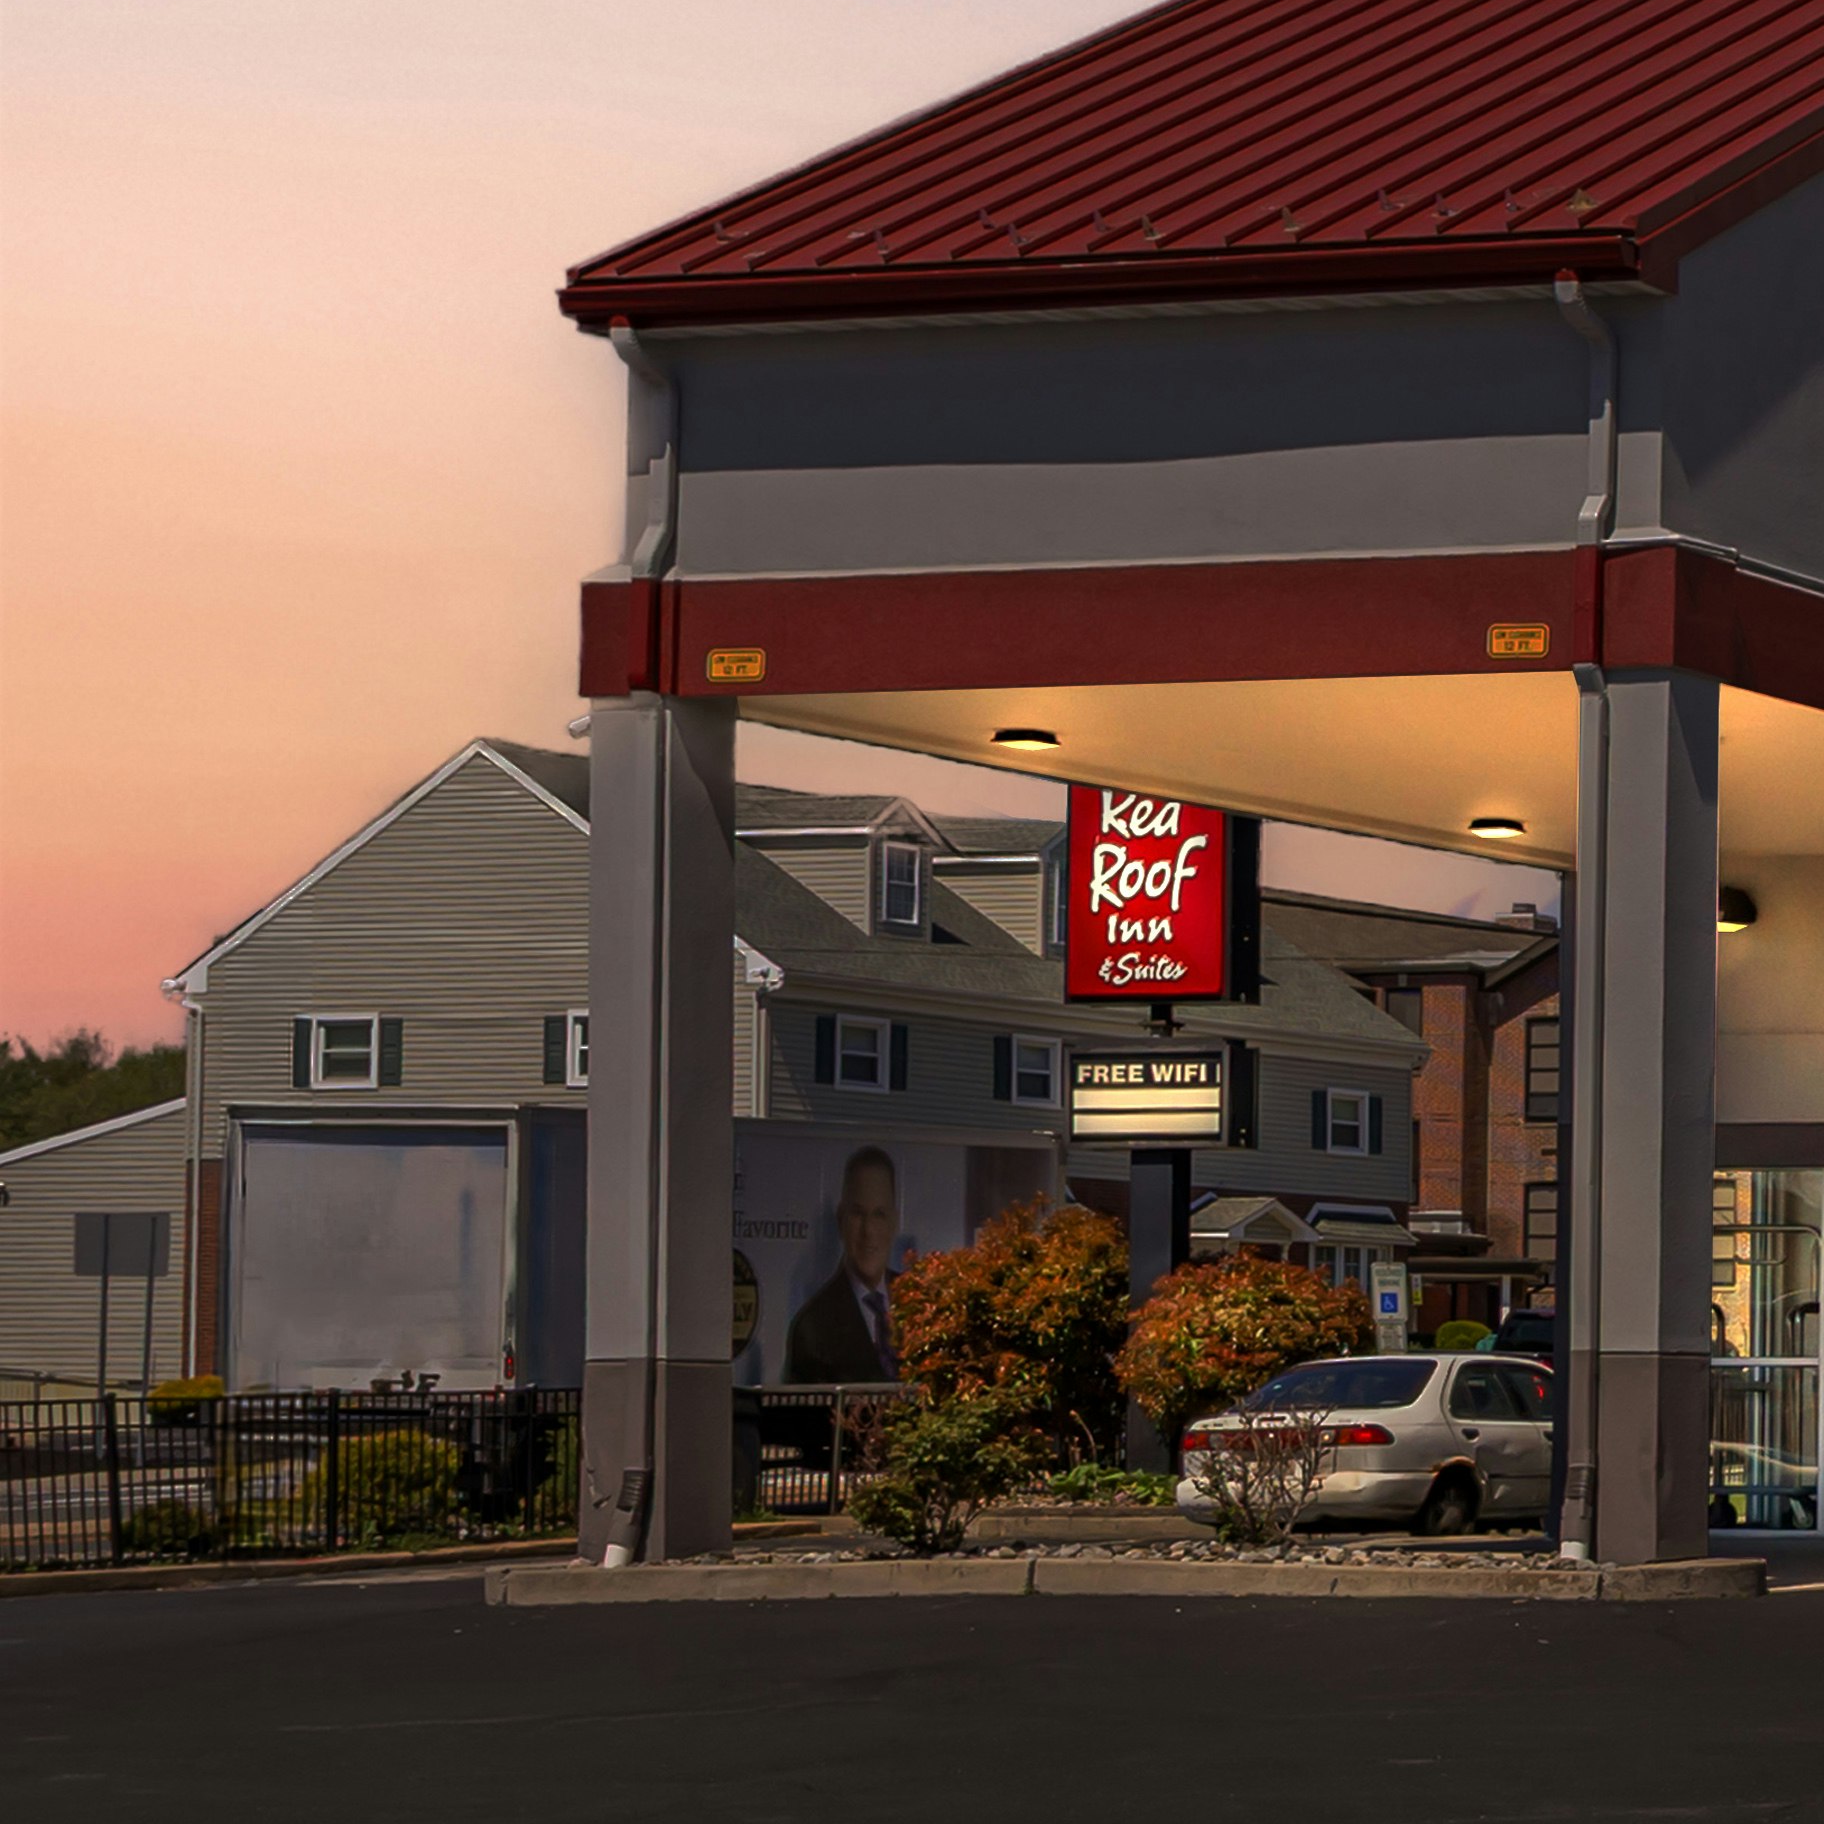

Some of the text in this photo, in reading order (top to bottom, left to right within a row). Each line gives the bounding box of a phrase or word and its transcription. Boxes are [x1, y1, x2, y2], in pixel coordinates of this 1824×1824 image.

[1090, 835, 1208, 913] Roof
[1108, 913, 1172, 943] Inn
[1112, 951, 1188, 985] Suites
[1077, 1063, 1145, 1084] FREE
[1151, 1063, 1207, 1083] WIFI
